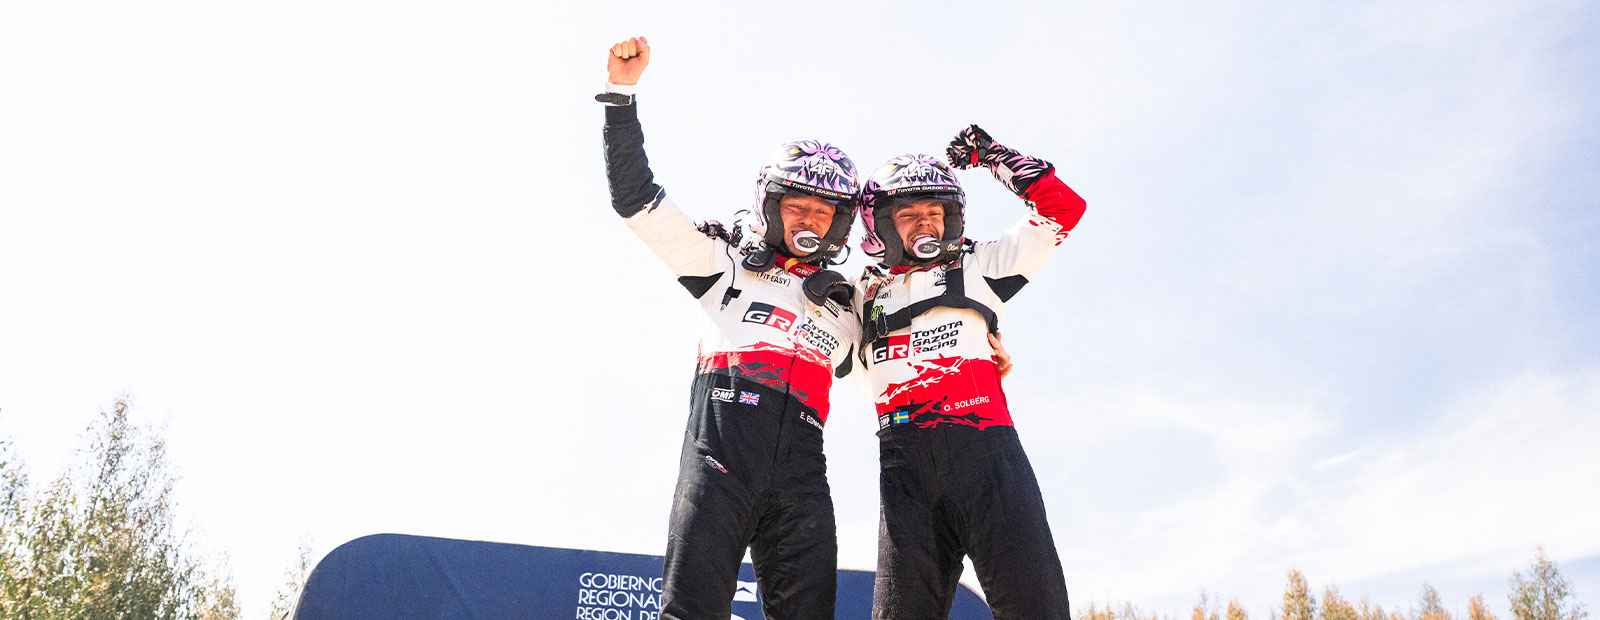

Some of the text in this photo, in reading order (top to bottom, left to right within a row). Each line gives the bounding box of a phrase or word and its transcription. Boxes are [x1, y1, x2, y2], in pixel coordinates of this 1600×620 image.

[792, 182, 815, 192] TOYOTA
[816, 188, 838, 197] GAZOO
[896, 186, 921, 194] TOYOTA
[743, 306, 794, 333] GR
[798, 323, 835, 350] GAZOO
[807, 316, 840, 348] TOYOTA
[911, 320, 963, 339] TOYOTA
[913, 329, 959, 347] GAZOO
[794, 329, 832, 357] Racing
[873, 340, 909, 363] GR
[913, 338, 957, 356] Racing
[711, 389, 735, 400] OMP
[943, 395, 990, 412] O. SOLBERG
[576, 606, 632, 620] REGION
